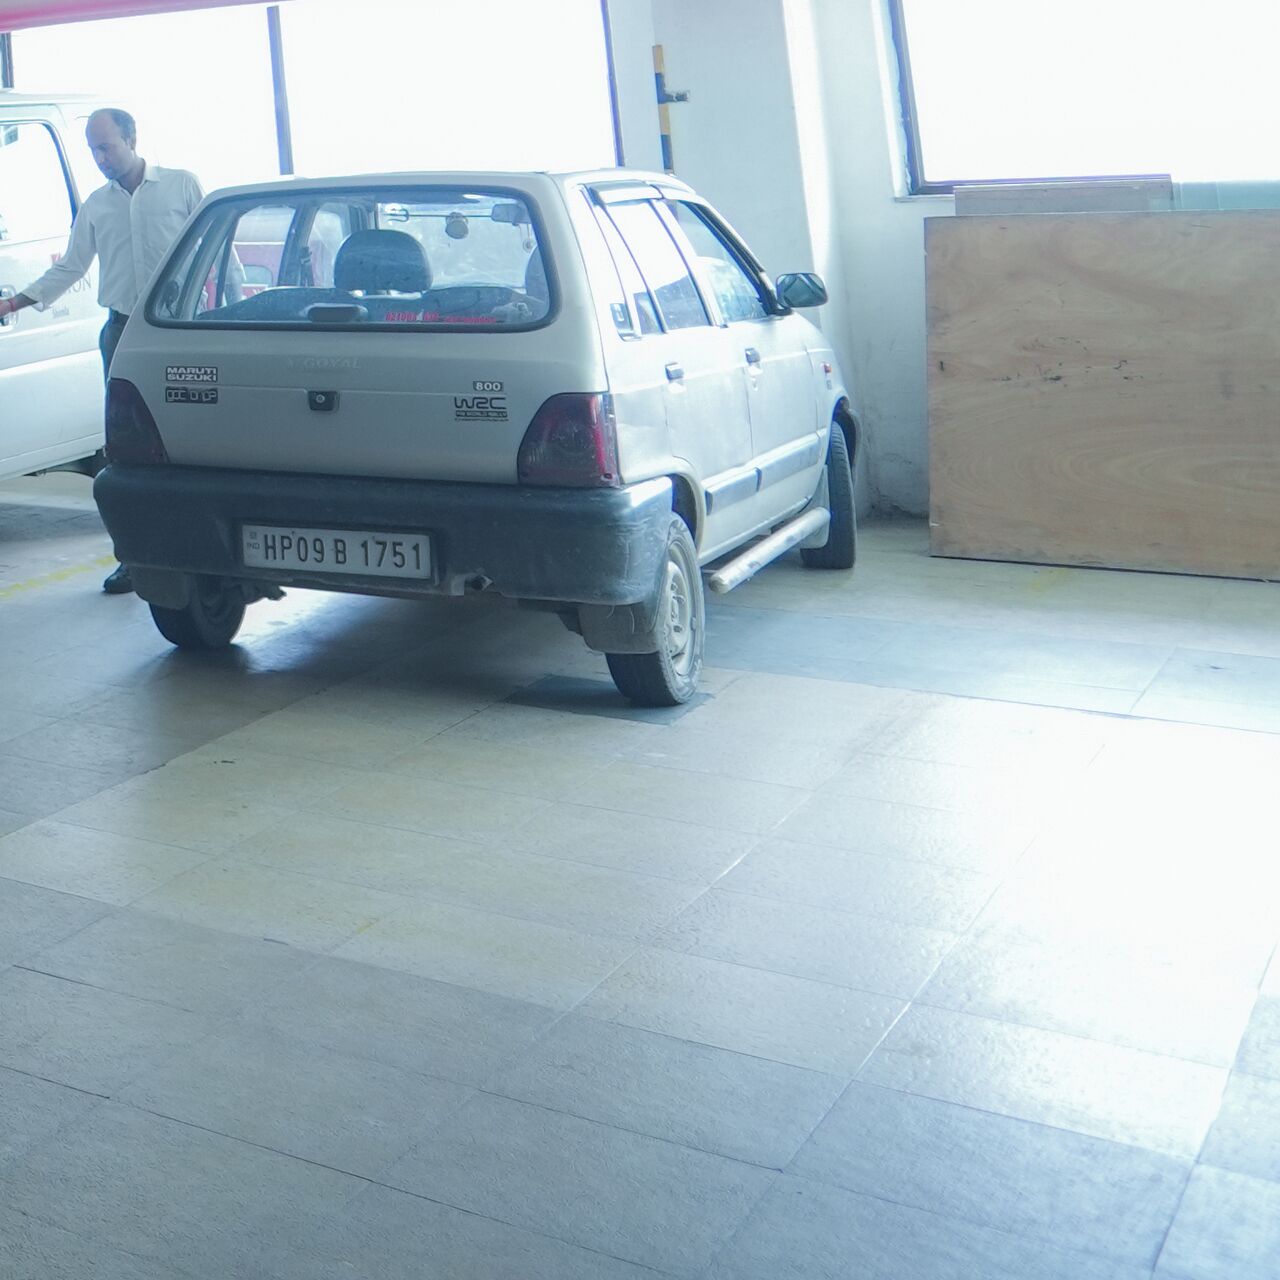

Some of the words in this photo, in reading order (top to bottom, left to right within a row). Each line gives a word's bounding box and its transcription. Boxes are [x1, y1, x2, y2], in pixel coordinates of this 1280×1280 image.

[476, 382, 501, 391] 800
[454, 397, 507, 409] WRC
[360, 540, 421, 570] 1751
